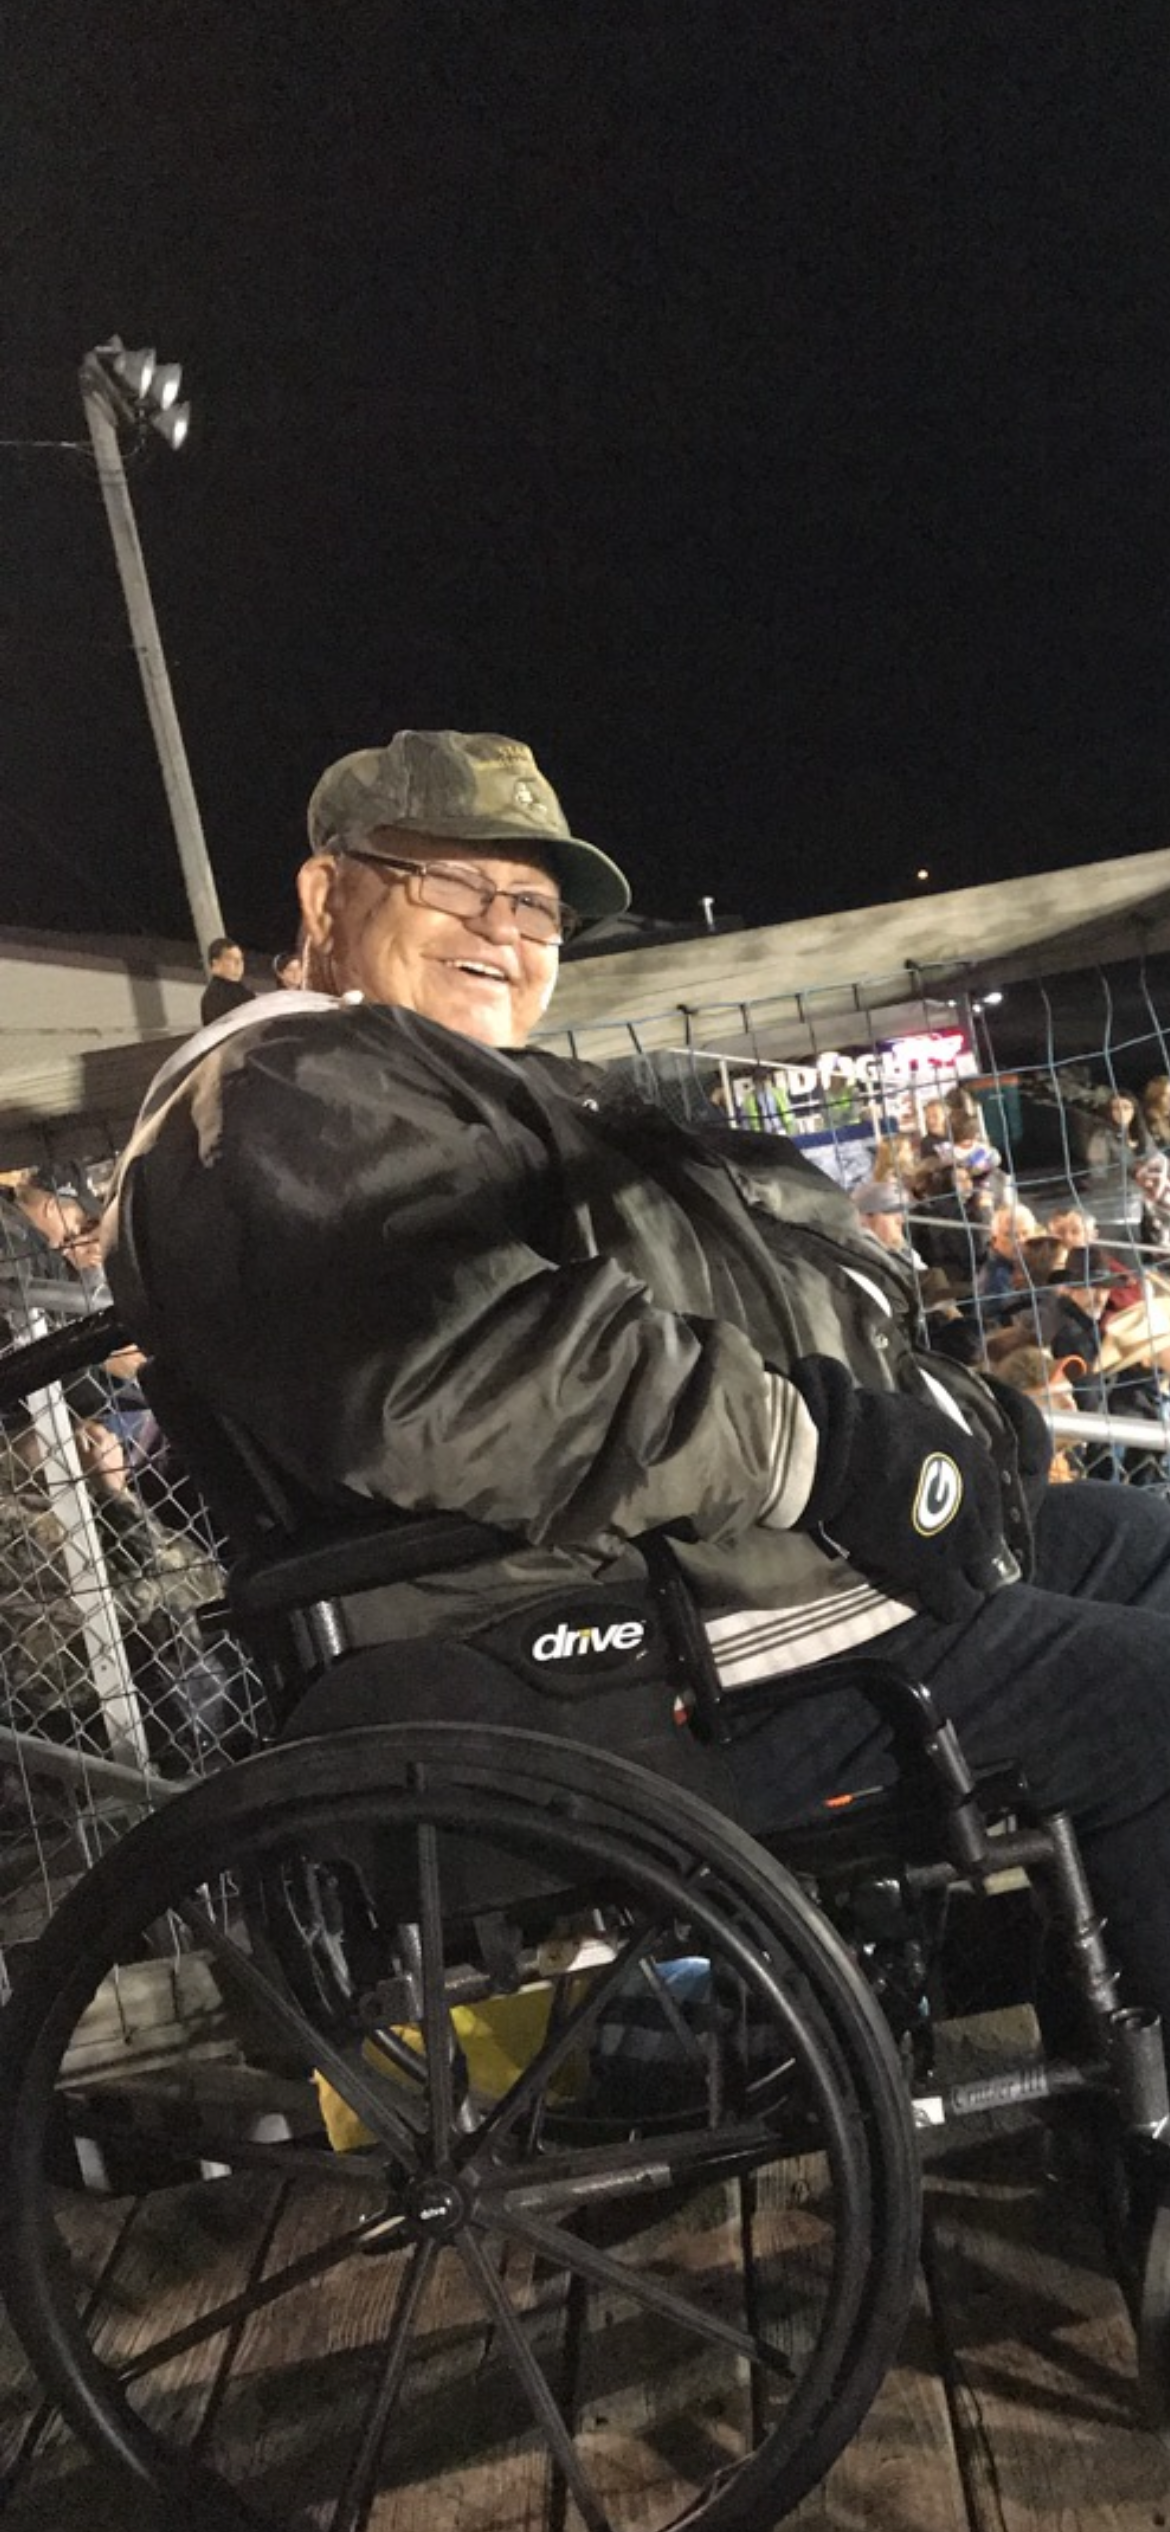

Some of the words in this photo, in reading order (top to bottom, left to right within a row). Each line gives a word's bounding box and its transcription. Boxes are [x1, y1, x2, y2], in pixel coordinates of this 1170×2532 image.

[733, 1067, 818, 1107] BD
[918, 1460, 958, 1528] G
[532, 1621, 645, 1661] drive
